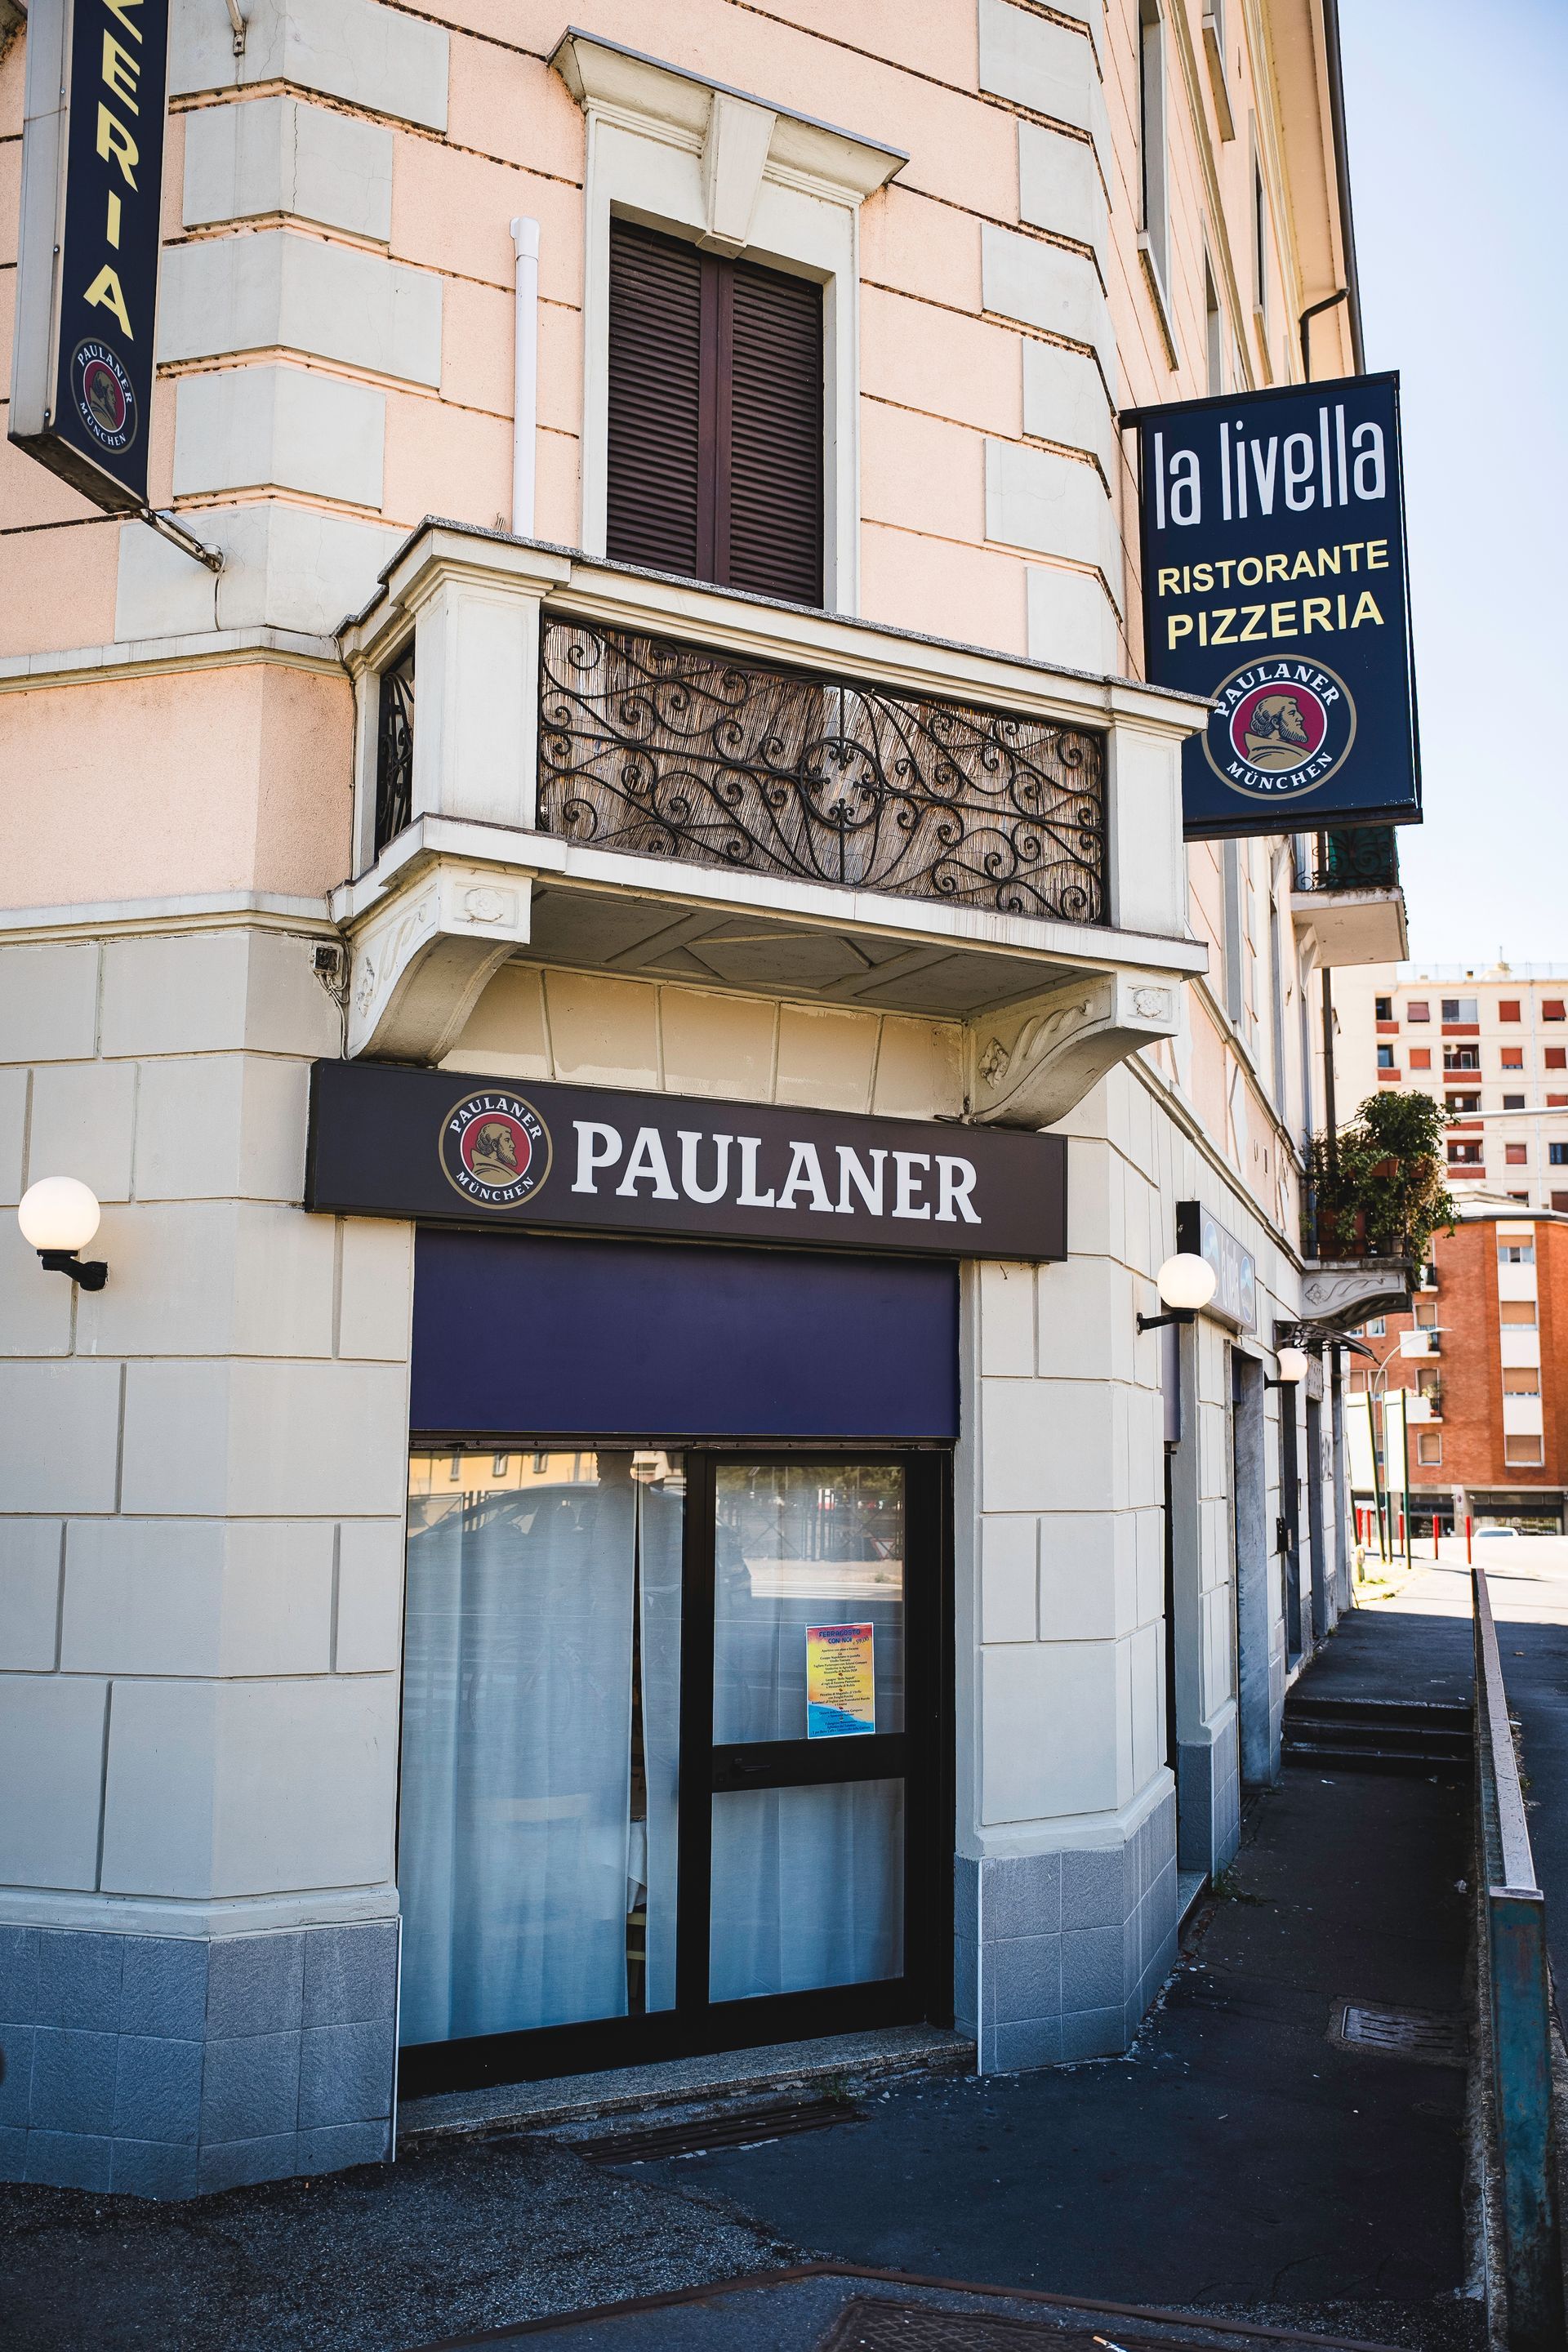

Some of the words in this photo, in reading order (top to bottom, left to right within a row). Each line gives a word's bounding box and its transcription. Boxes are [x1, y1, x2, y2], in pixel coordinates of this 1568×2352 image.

[78, 345, 132, 403] PAULANER
[1155, 433, 1201, 529] la
[1220, 405, 1386, 521] livella
[1159, 540, 1389, 596] RISTORANTE
[1168, 591, 1384, 650] PIZZERIA
[1214, 663, 1339, 717] PAULANER
[1227, 751, 1333, 790] MÜNCHEN
[449, 1097, 542, 1140] PAULANER
[456, 1171, 534, 1201] MÜNCHEN
[572, 1121, 982, 1223] PAULANER
[818, 1628, 861, 1637] FERRAGOSTO
